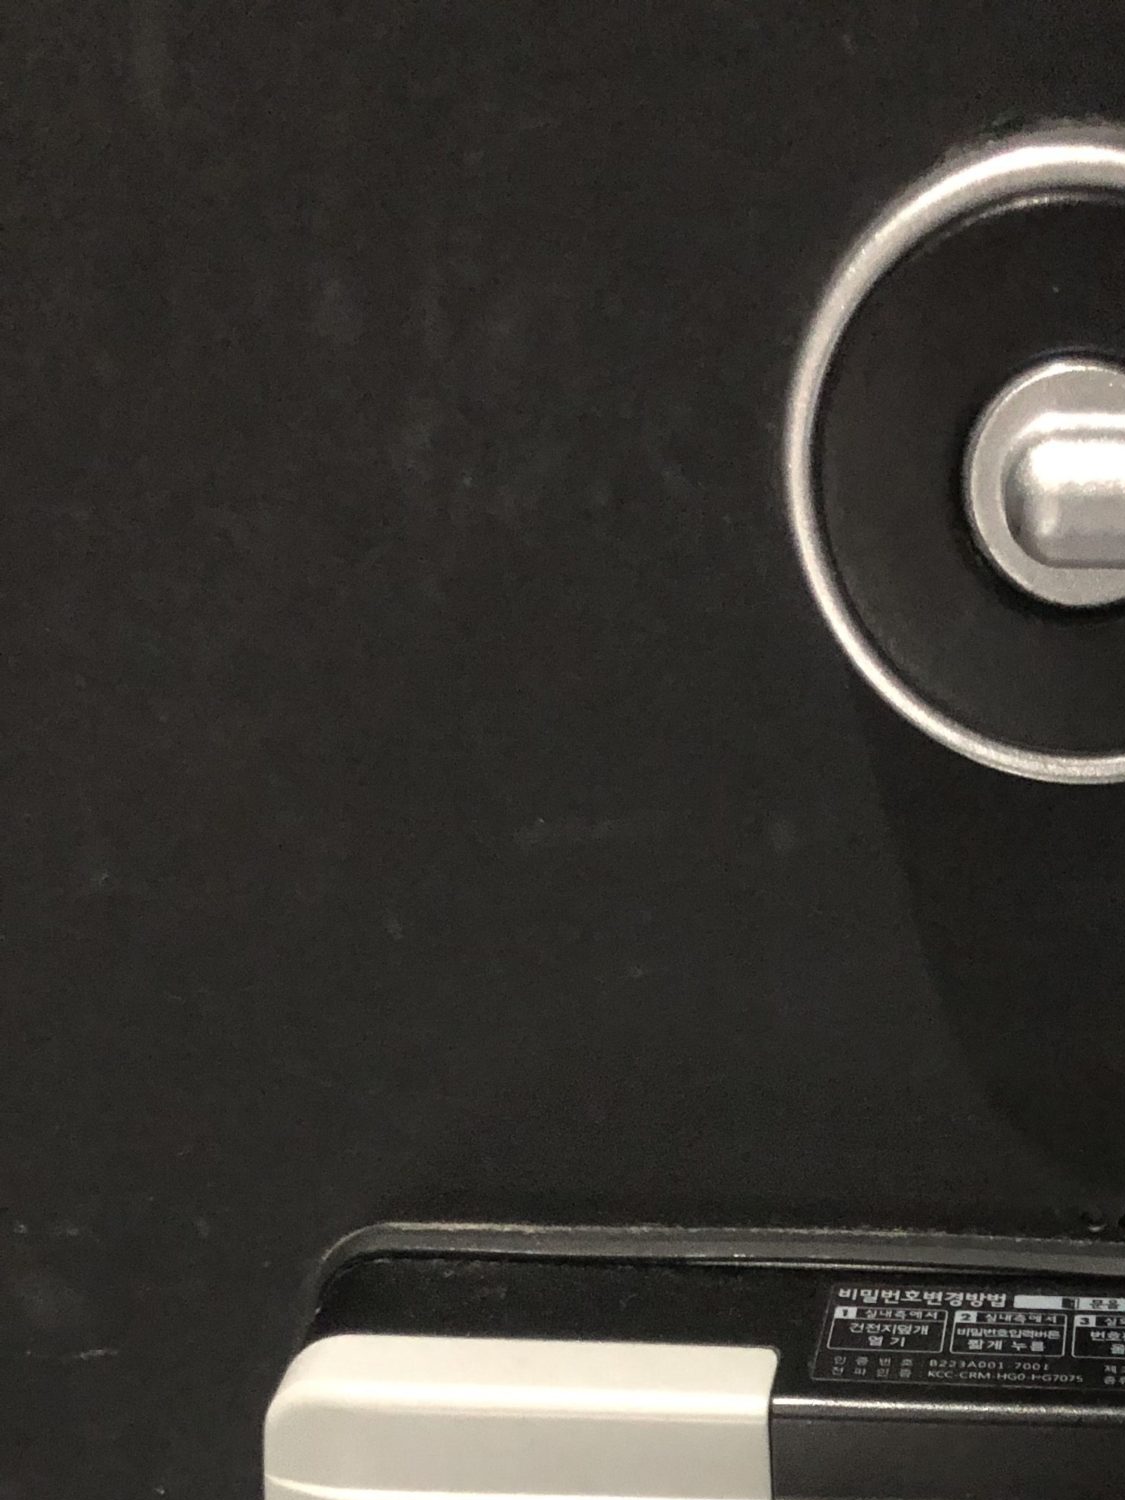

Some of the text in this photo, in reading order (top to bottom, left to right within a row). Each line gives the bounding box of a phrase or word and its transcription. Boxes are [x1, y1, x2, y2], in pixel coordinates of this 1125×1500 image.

[838, 1288, 1006, 1308] 비밀번호변경방법
[1090, 1299, 1119, 1310] 문을
[865, 1309, 938, 1320] 실내측에서
[961, 1313, 1057, 1324] 2 실내측에서
[1080, 1317, 1090, 1325] 3
[849, 1322, 929, 1335] 건전지덮개
[957, 1328, 1060, 1340] 비밀번호입력버튼
